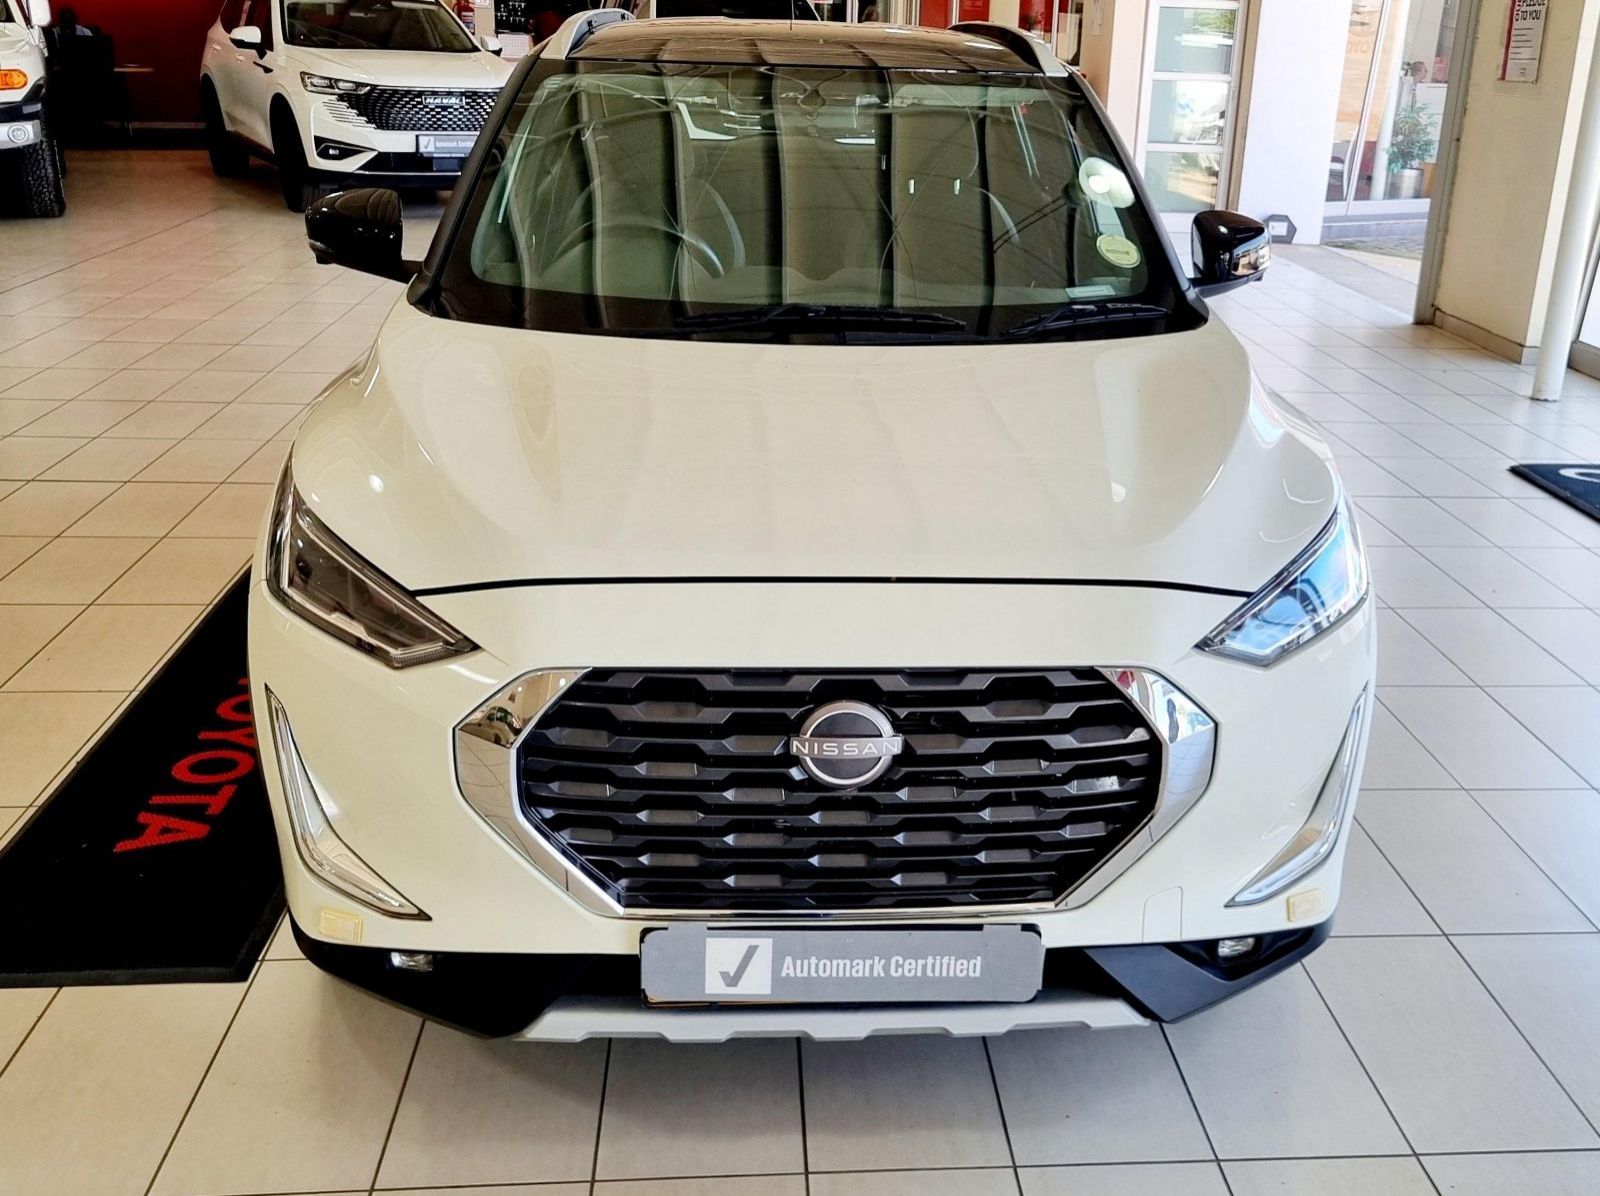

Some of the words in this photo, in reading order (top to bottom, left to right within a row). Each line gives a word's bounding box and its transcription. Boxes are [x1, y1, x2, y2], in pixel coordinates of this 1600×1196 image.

[1521, 10, 1528, 21] TO
[1529, 10, 1541, 20] YOU
[425, 96, 461, 104] HAVAL
[792, 740, 898, 756] NISSAN
[113, 677, 257, 853] OYOTA
[781, 955, 886, 978] Automark
[889, 955, 982, 978] Certified
